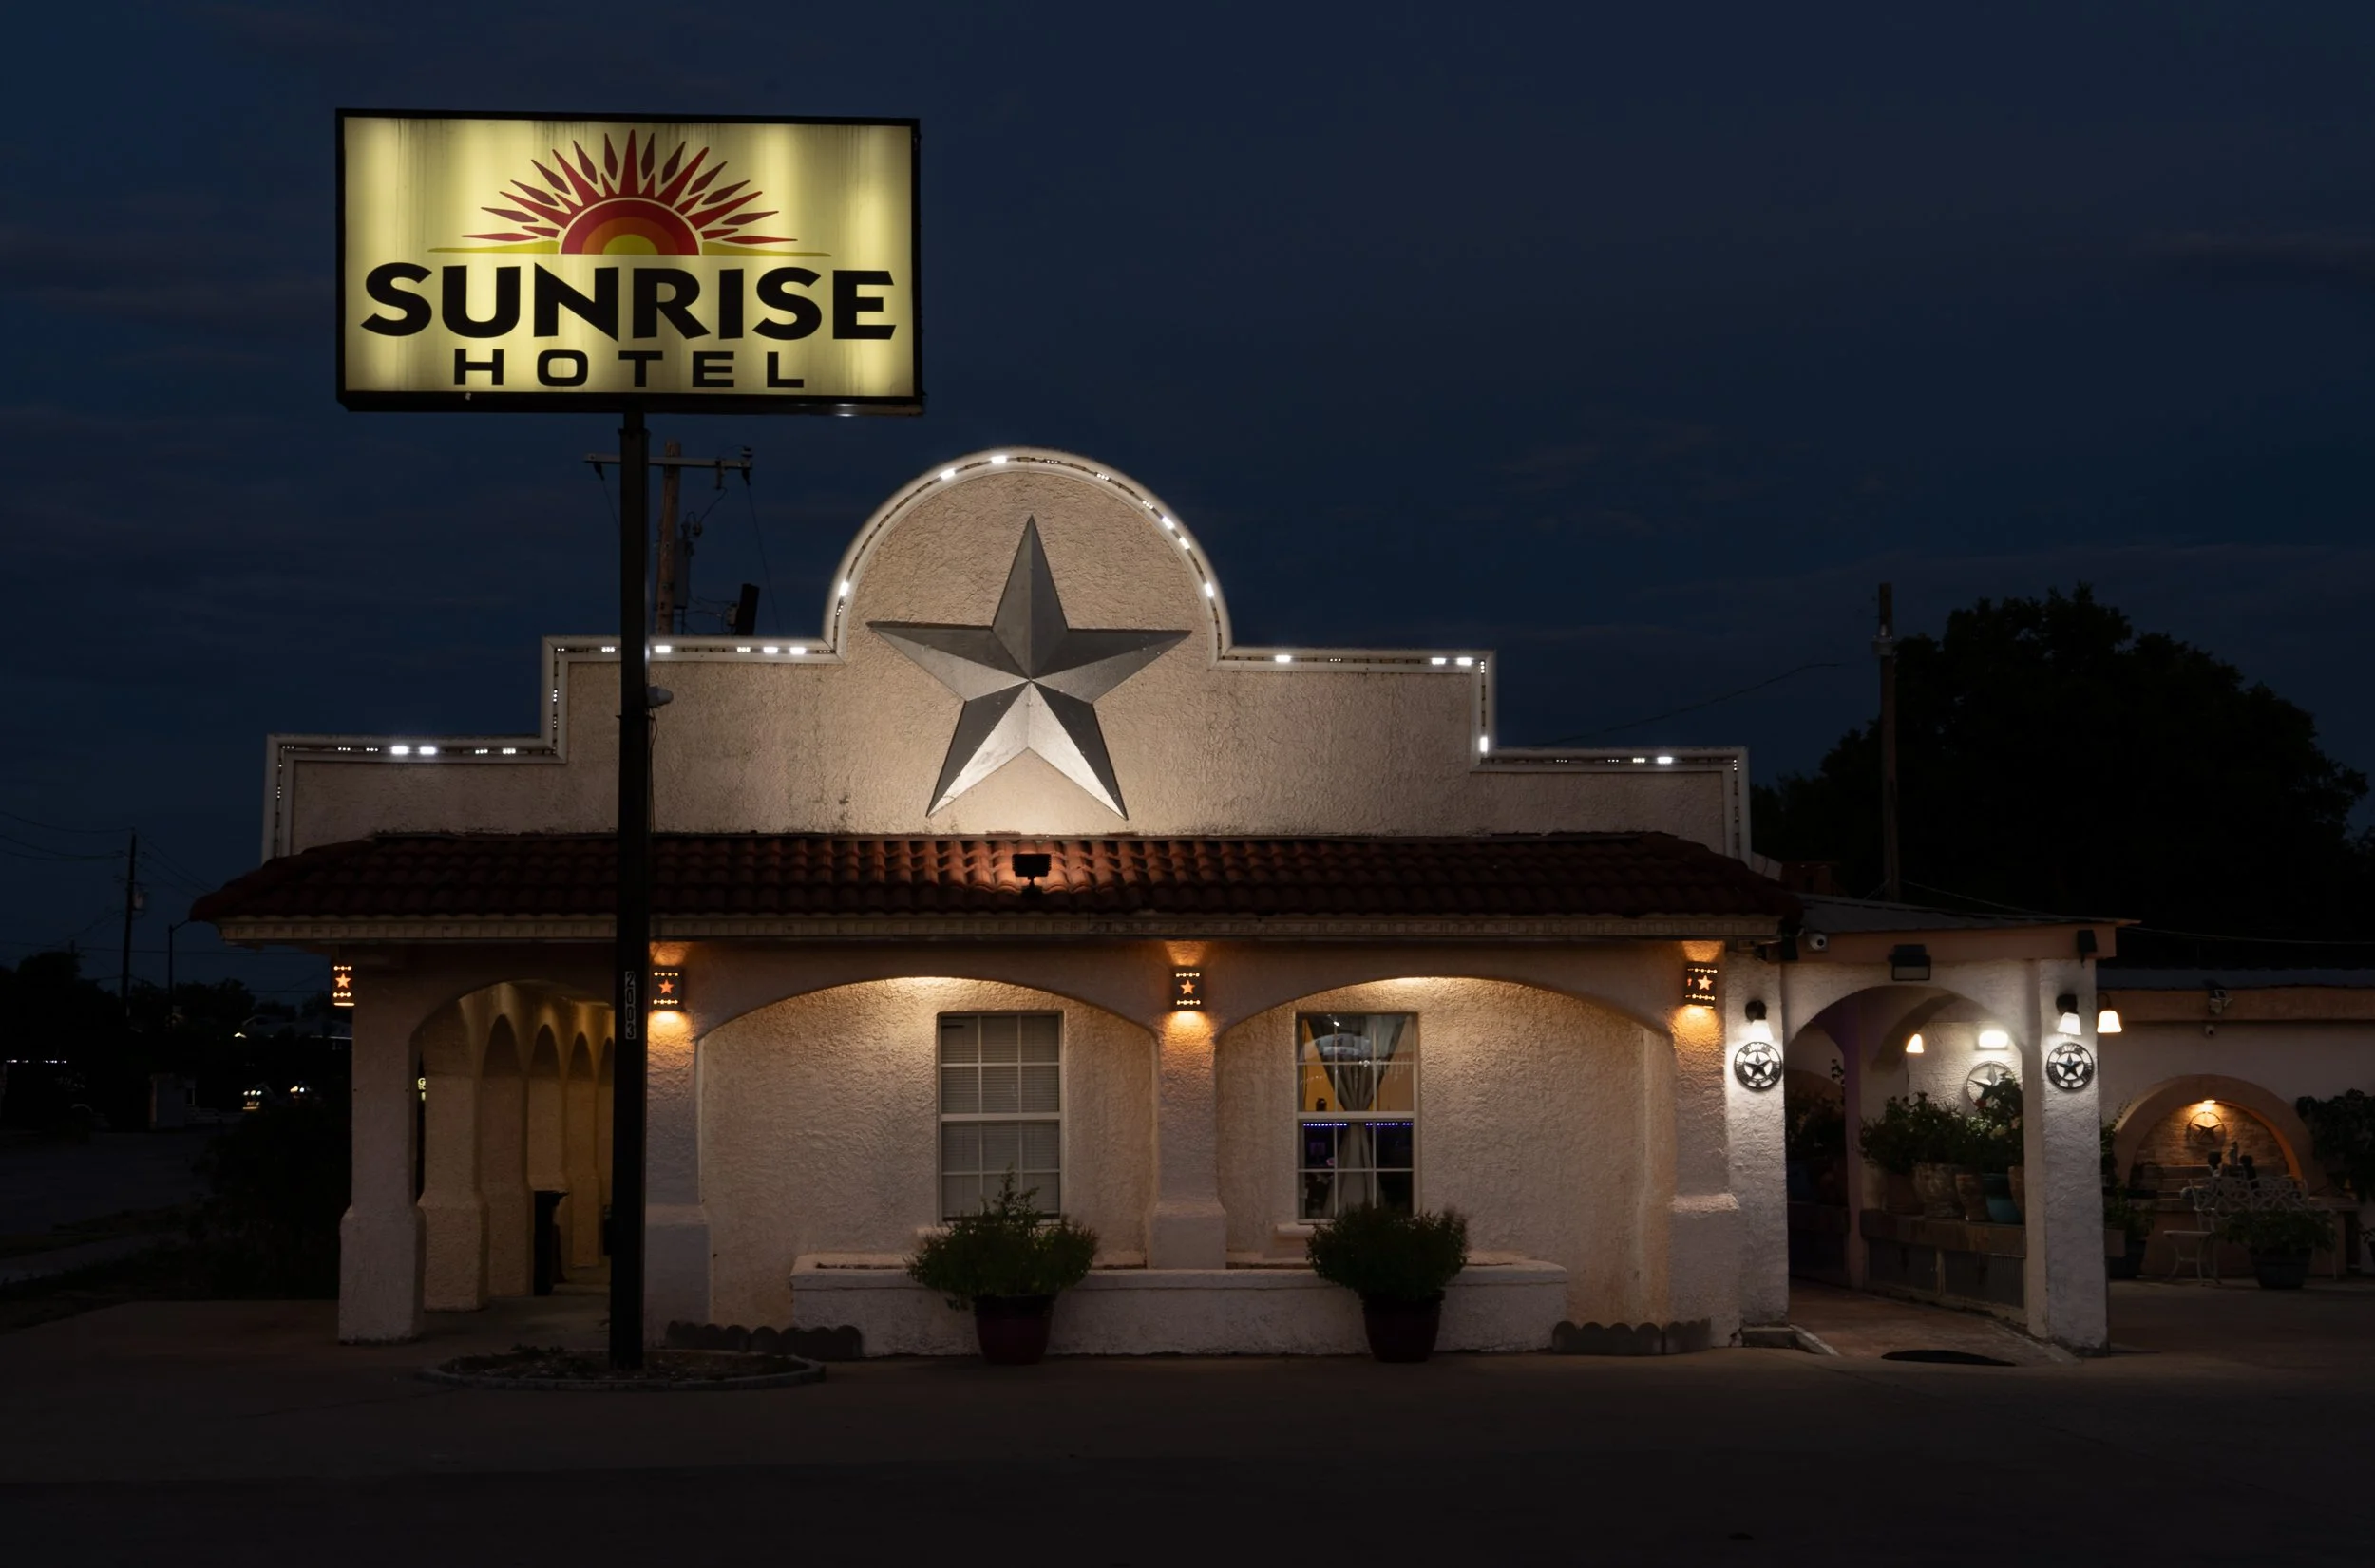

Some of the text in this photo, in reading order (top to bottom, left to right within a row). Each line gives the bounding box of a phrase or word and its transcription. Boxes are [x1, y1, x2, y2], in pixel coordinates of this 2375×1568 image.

[360, 262, 896, 341] SUNRISE
[454, 349, 805, 388] HOTEL
[626, 973, 636, 1038] 2003
